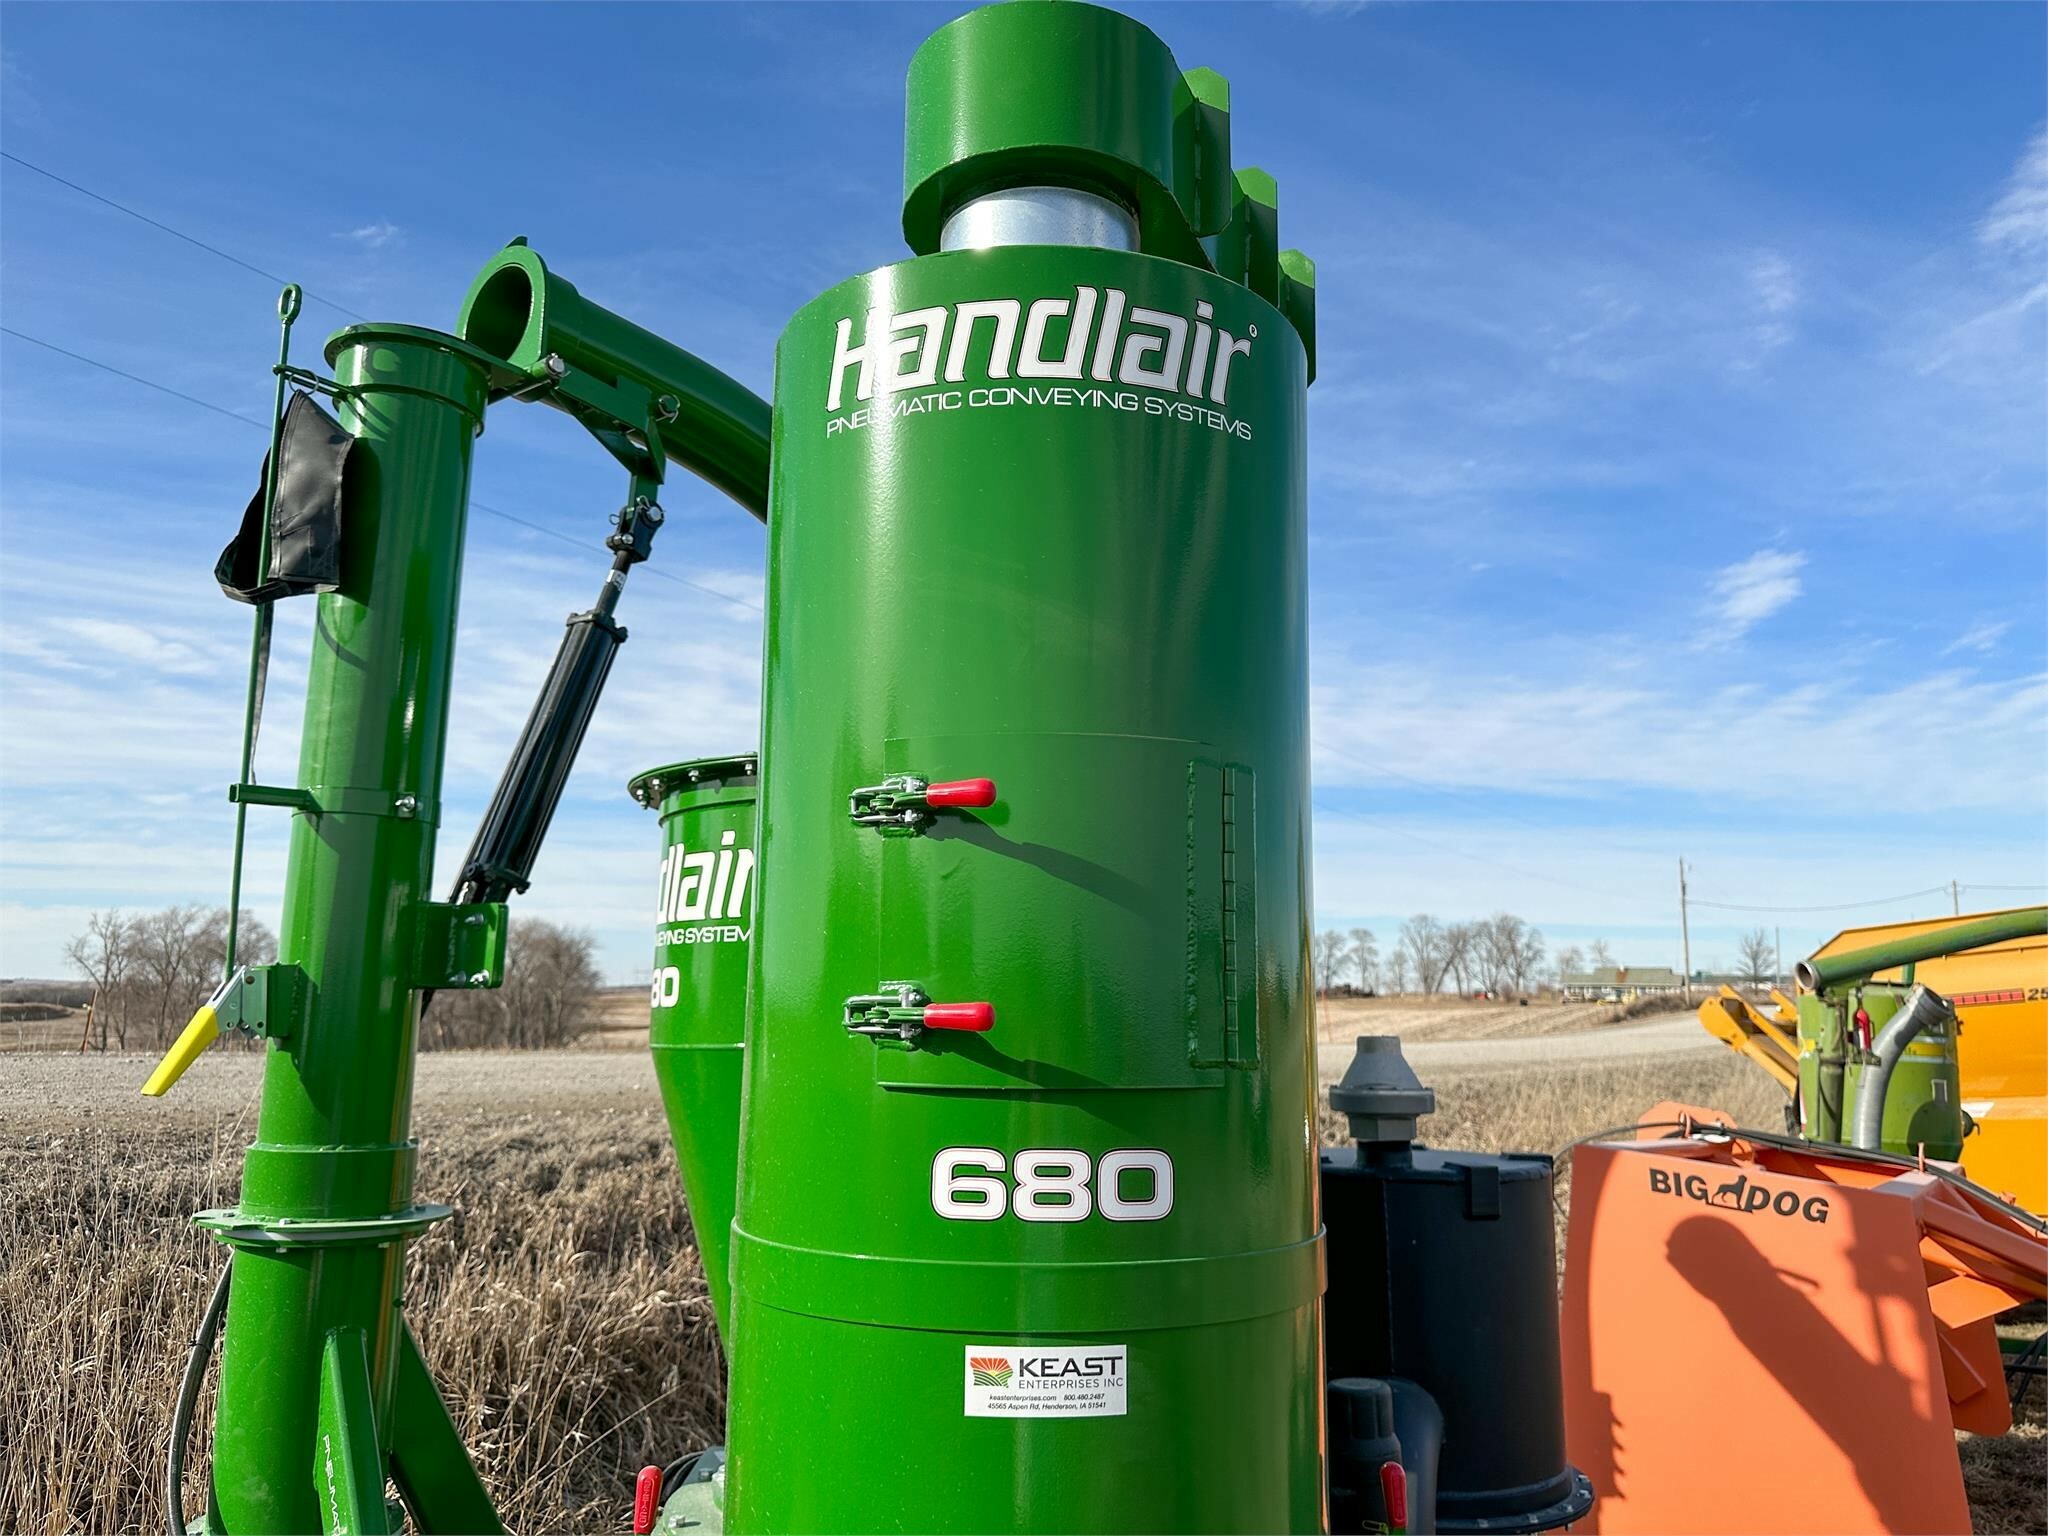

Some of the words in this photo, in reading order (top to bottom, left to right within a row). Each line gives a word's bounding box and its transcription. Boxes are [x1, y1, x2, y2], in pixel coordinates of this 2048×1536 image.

[968, 386, 1139, 412] CONVEYING
[1144, 397, 1252, 441] SYSTEMS
[930, 1146, 1174, 1222] 680
[1649, 1168, 1710, 1205] BIG
[1744, 1185, 1829, 1224] DOG
[1019, 1356, 1123, 1378] KEAST
[1019, 1378, 1100, 1390] ENTERPRISES
[1103, 1377, 1124, 1388] INC
[989, 1394, 1057, 1402] keastenterprises.com
[1008, 1402, 1029, 1411] Aspen
